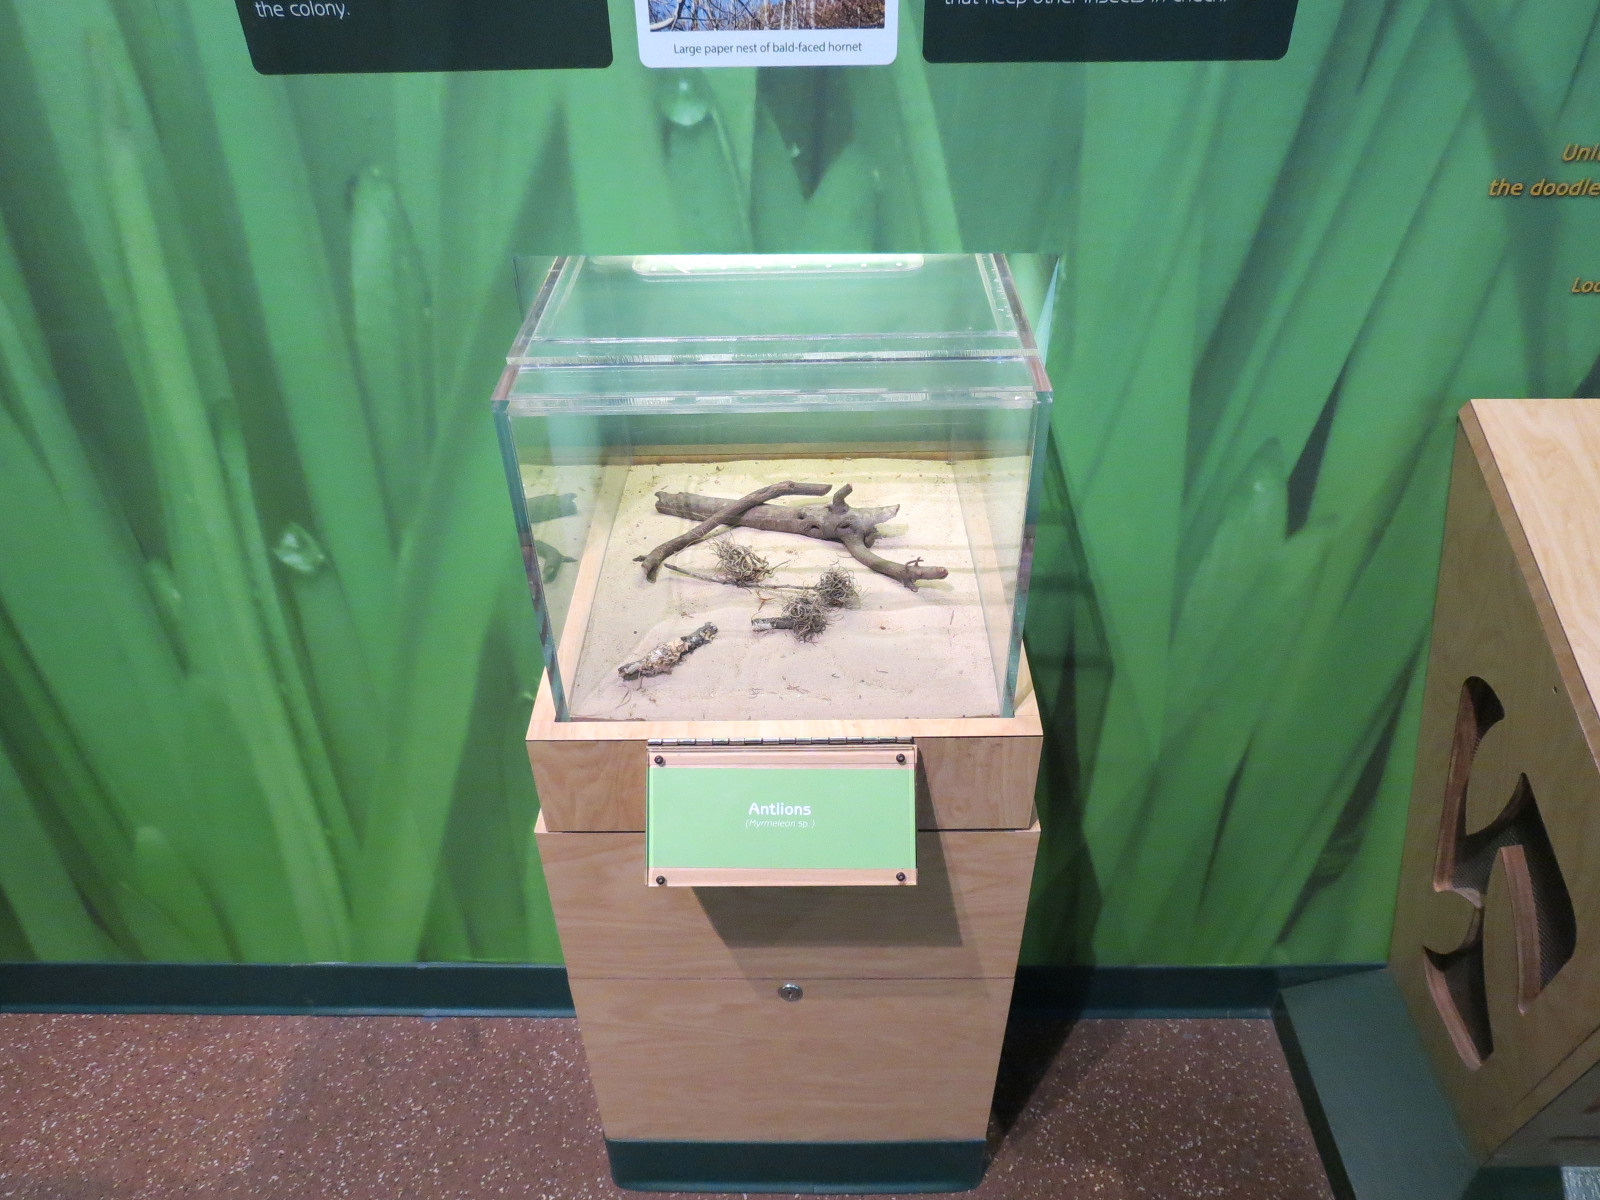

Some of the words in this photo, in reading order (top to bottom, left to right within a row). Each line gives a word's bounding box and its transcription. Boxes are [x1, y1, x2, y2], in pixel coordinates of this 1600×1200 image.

[255, 1, 285, 18] the
[290, 0, 351, 20] colony.
[673, 43, 702, 57] Large
[704, 44, 733, 56] paper
[736, 43, 758, 54] nest
[759, 42, 771, 53] of
[772, 42, 826, 53] bald-faced
[828, 41, 863, 52] hornet
[1489, 178, 1524, 196] the
[748, 801, 812, 816] Antlions
